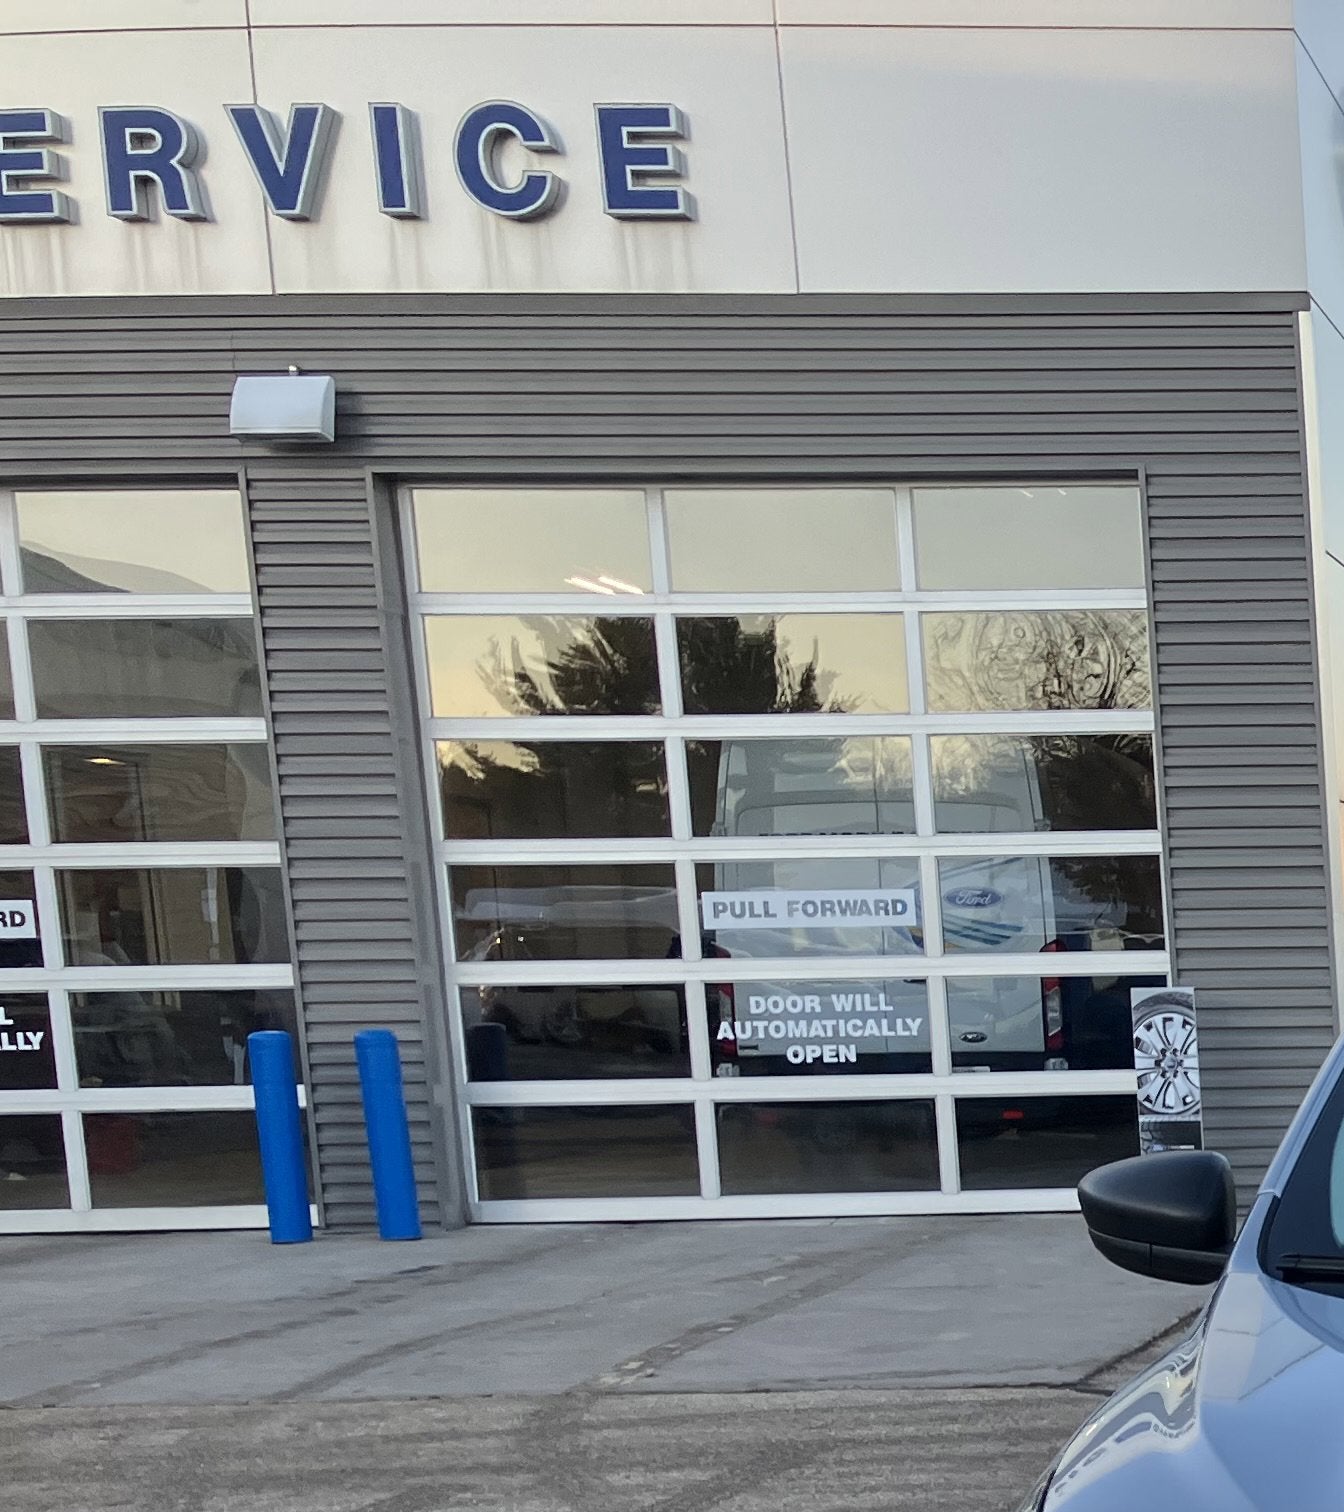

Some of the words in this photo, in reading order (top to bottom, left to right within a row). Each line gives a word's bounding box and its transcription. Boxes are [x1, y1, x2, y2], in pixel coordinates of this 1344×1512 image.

[713, 900, 778, 919] PULL
[787, 898, 908, 918] FORWARD
[750, 994, 822, 1014] DOOR
[831, 993, 894, 1012] WILL
[716, 1017, 923, 1040] AUTOMATICALLY
[786, 1044, 858, 1064] OPEN
